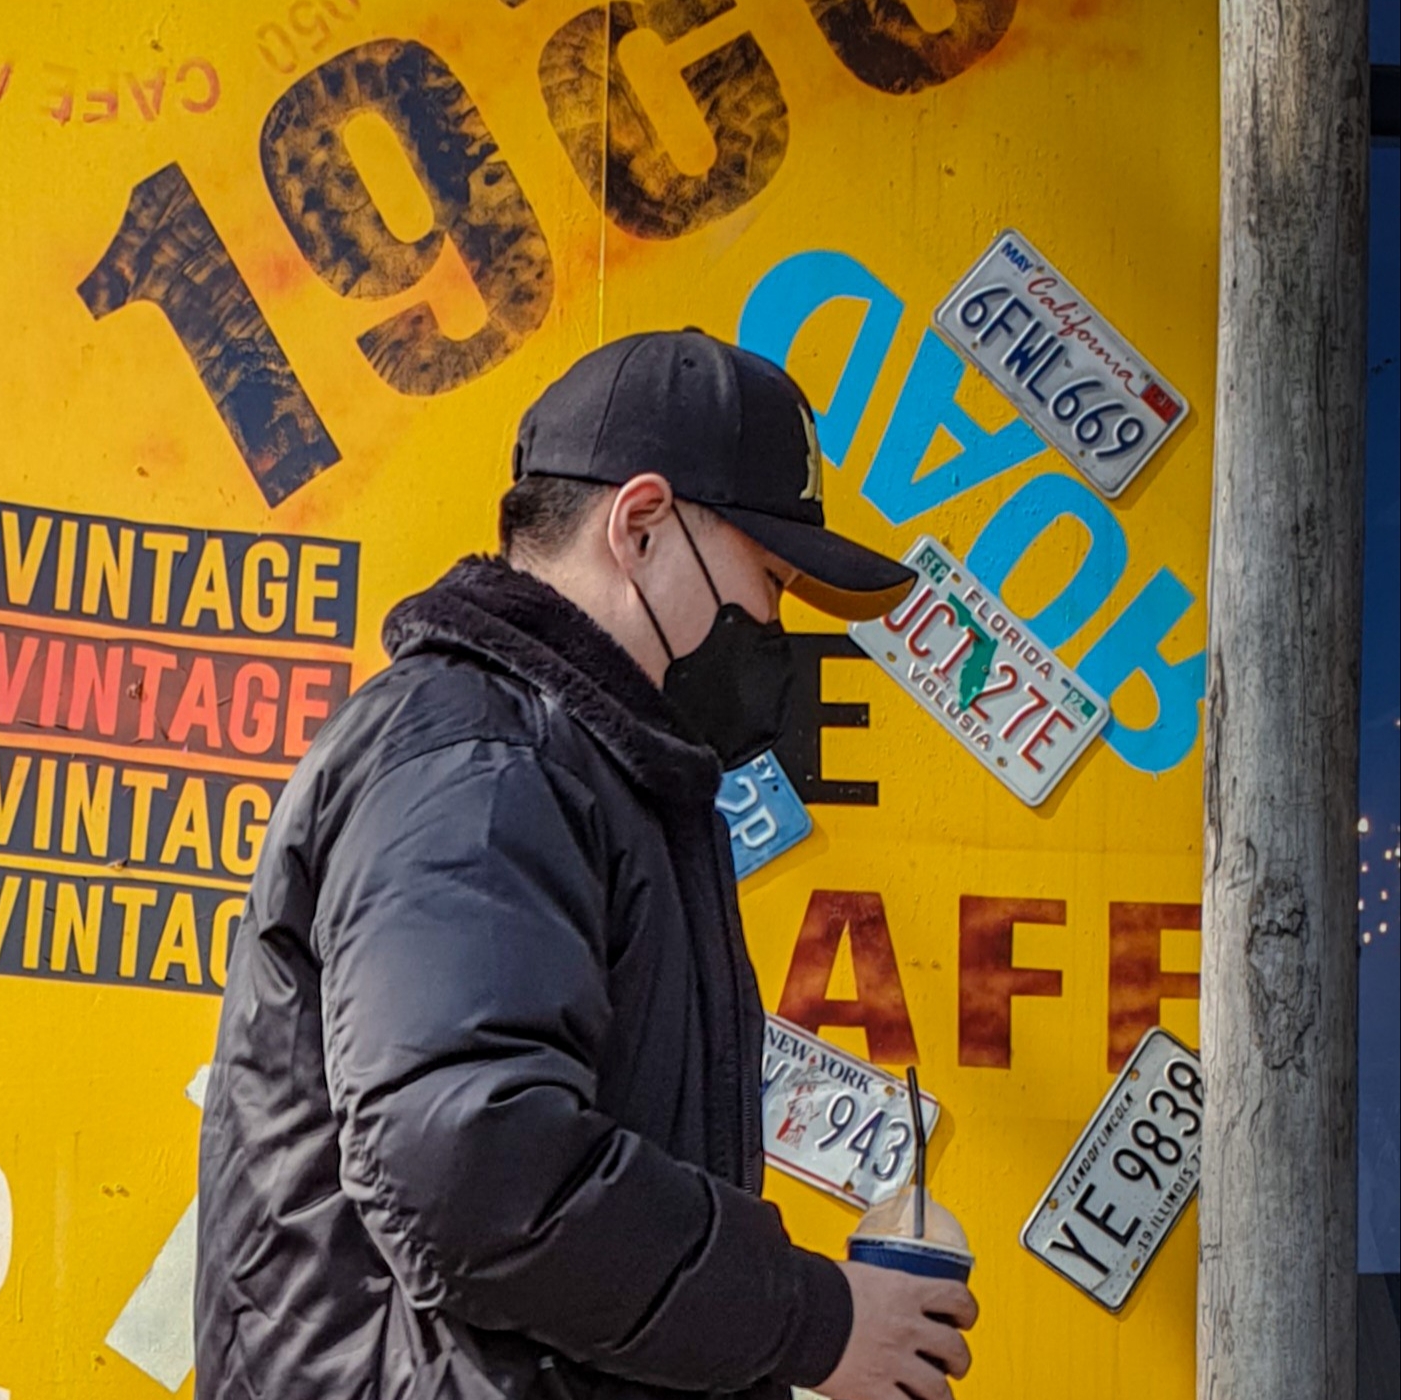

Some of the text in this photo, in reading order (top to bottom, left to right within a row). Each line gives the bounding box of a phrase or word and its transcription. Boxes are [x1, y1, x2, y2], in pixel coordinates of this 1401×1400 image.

[1000, 241, 1035, 273] MAY
[957, 284, 1146, 461] 6FWL669
[1027, 276, 1140, 399] California
[1, 509, 342, 639] VINTAGE
[917, 548, 949, 584] SEP
[961, 586, 1057, 684] FLORIDA
[907, 661, 995, 752] VOLUSIA
[969, 661, 1076, 772] 27E
[765, 1026, 876, 1096] NEW YORK
[813, 1091, 912, 1183] 943
[1096, 1090, 1135, 1150] LINCOLN
[1046, 1182, 1142, 1276] YE
[1149, 1167, 1195, 1232] ILLINOIS
